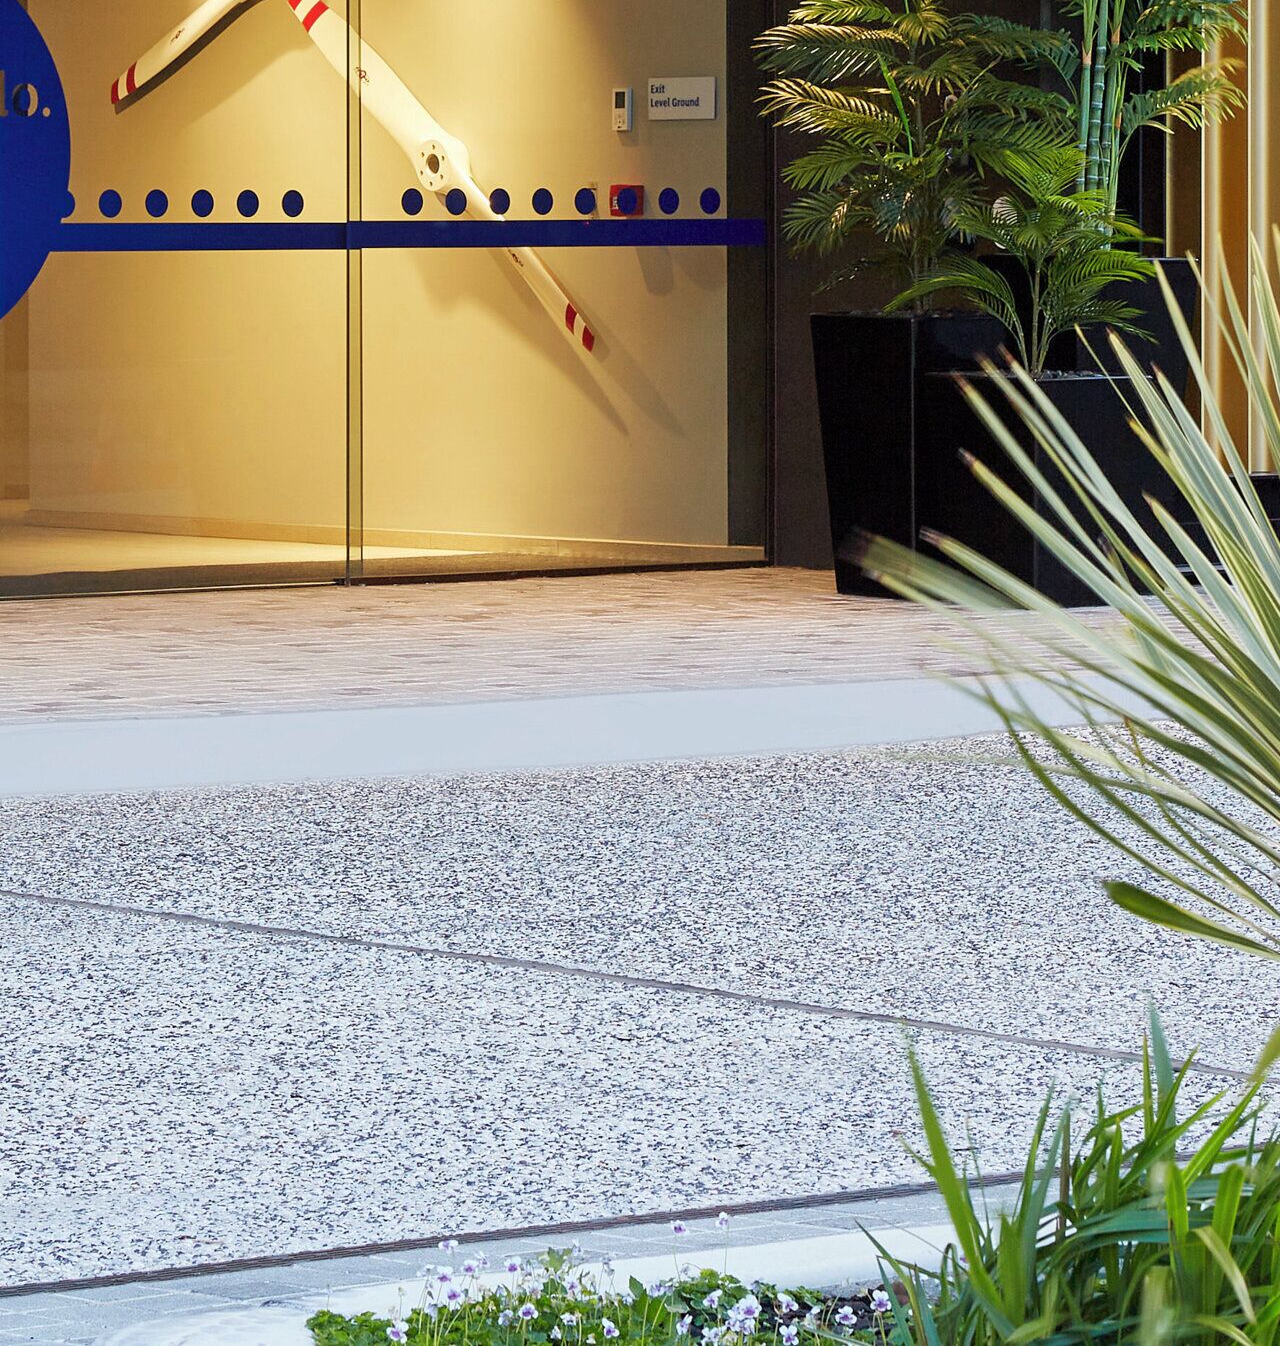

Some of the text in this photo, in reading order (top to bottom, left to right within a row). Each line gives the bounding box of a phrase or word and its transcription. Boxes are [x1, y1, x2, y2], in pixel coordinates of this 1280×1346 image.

[650, 84, 665, 94] Exit
[650, 96, 700, 108] Level Ground
